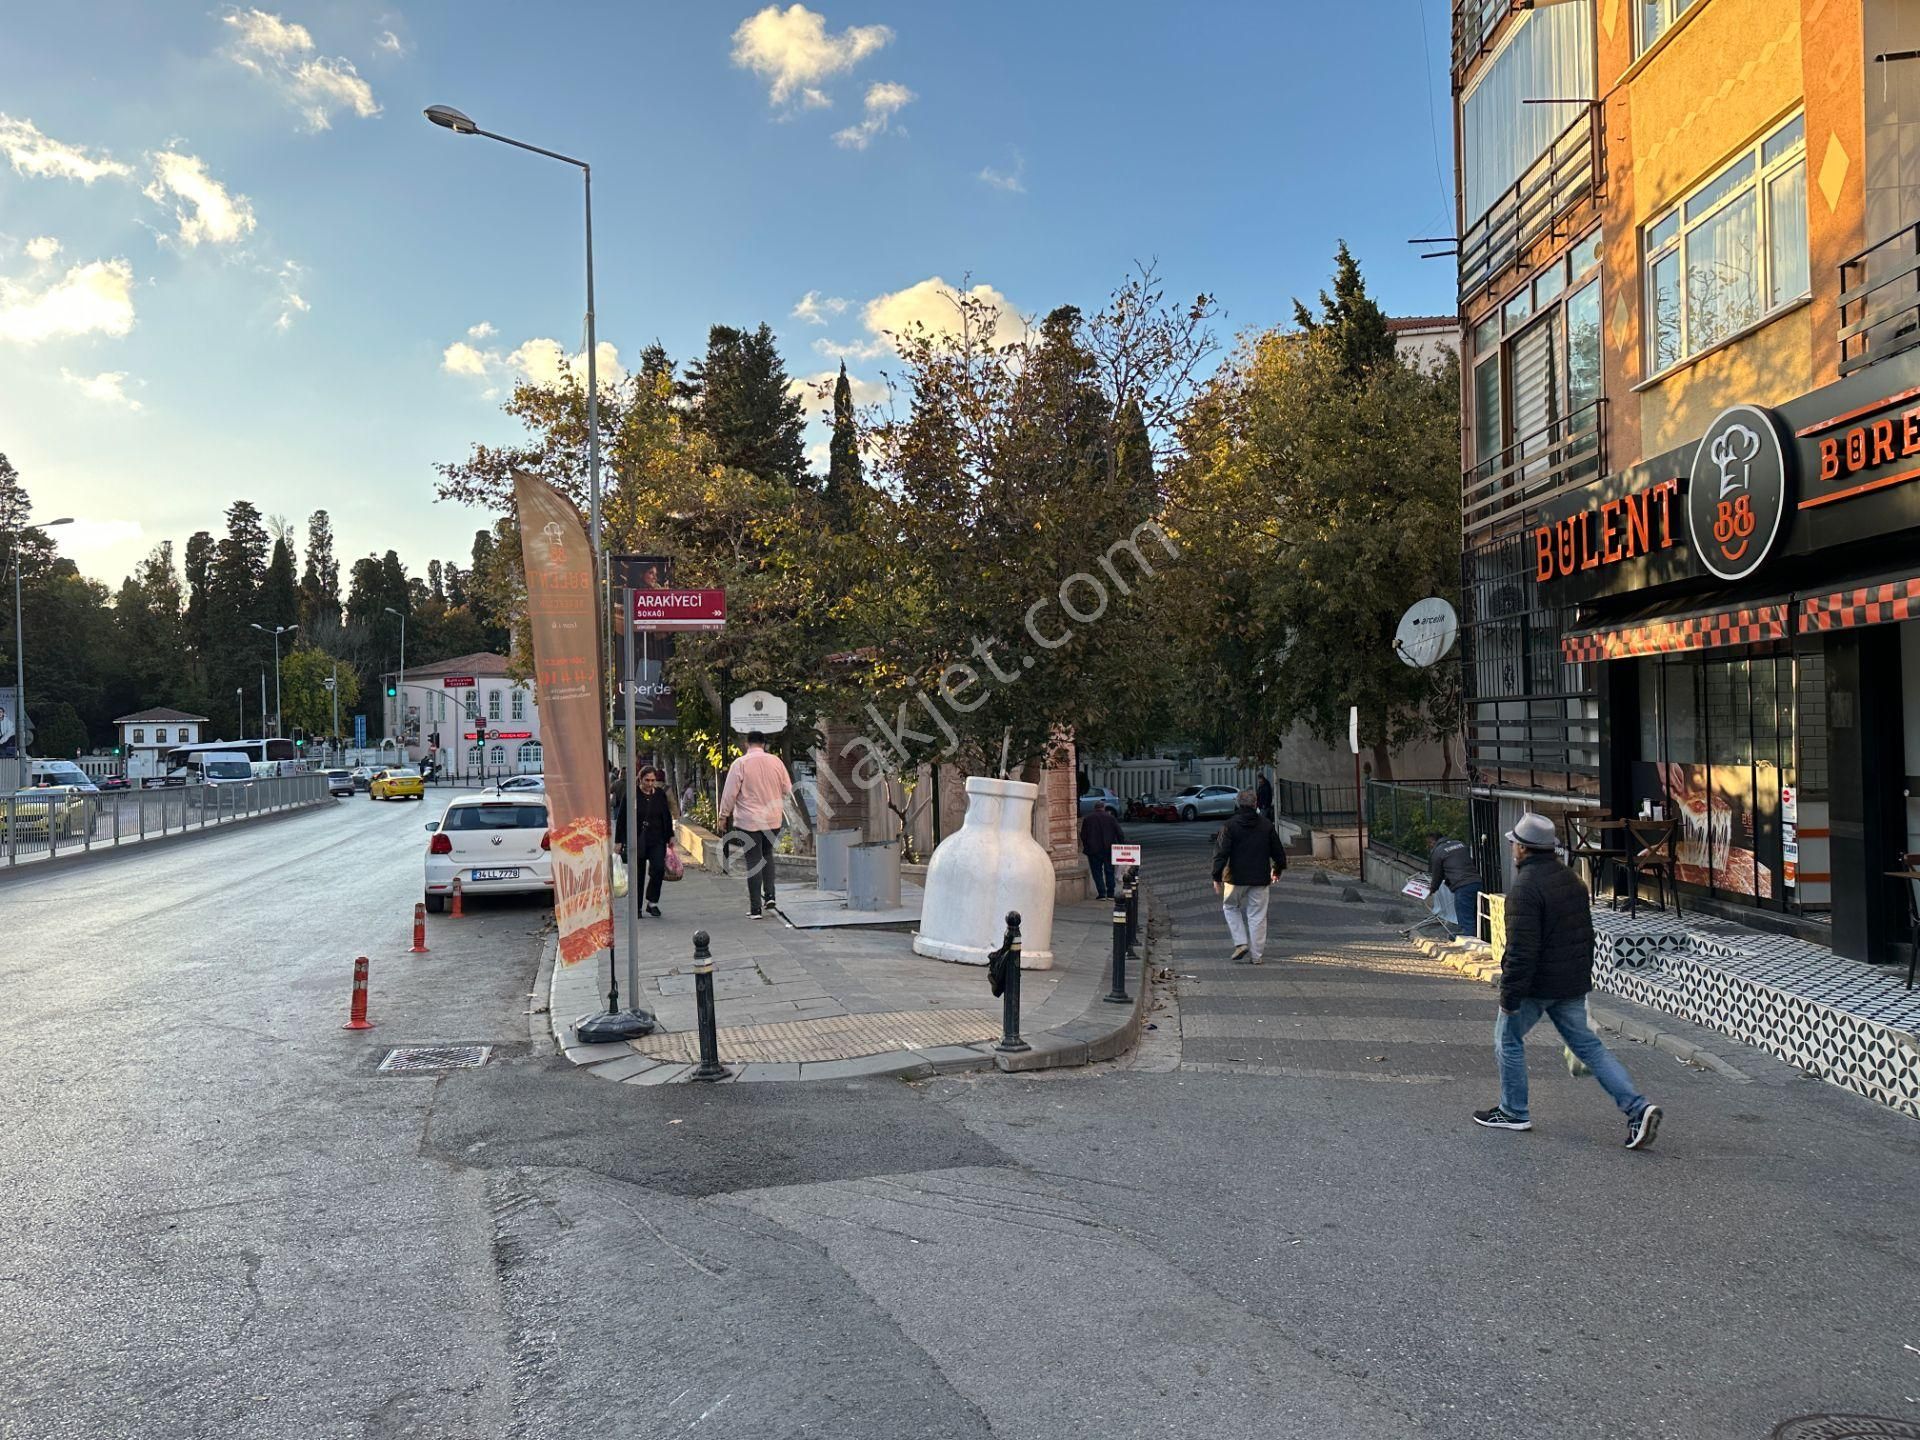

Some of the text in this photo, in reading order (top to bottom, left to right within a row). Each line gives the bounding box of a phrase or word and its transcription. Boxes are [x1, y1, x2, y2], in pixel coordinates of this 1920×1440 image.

[1535, 478, 1677, 582] BÜLENT
[637, 593, 702, 607] ARAKİYECİ
[637, 609, 665, 617] SOKAĞI
[477, 870, 487, 878] 34
